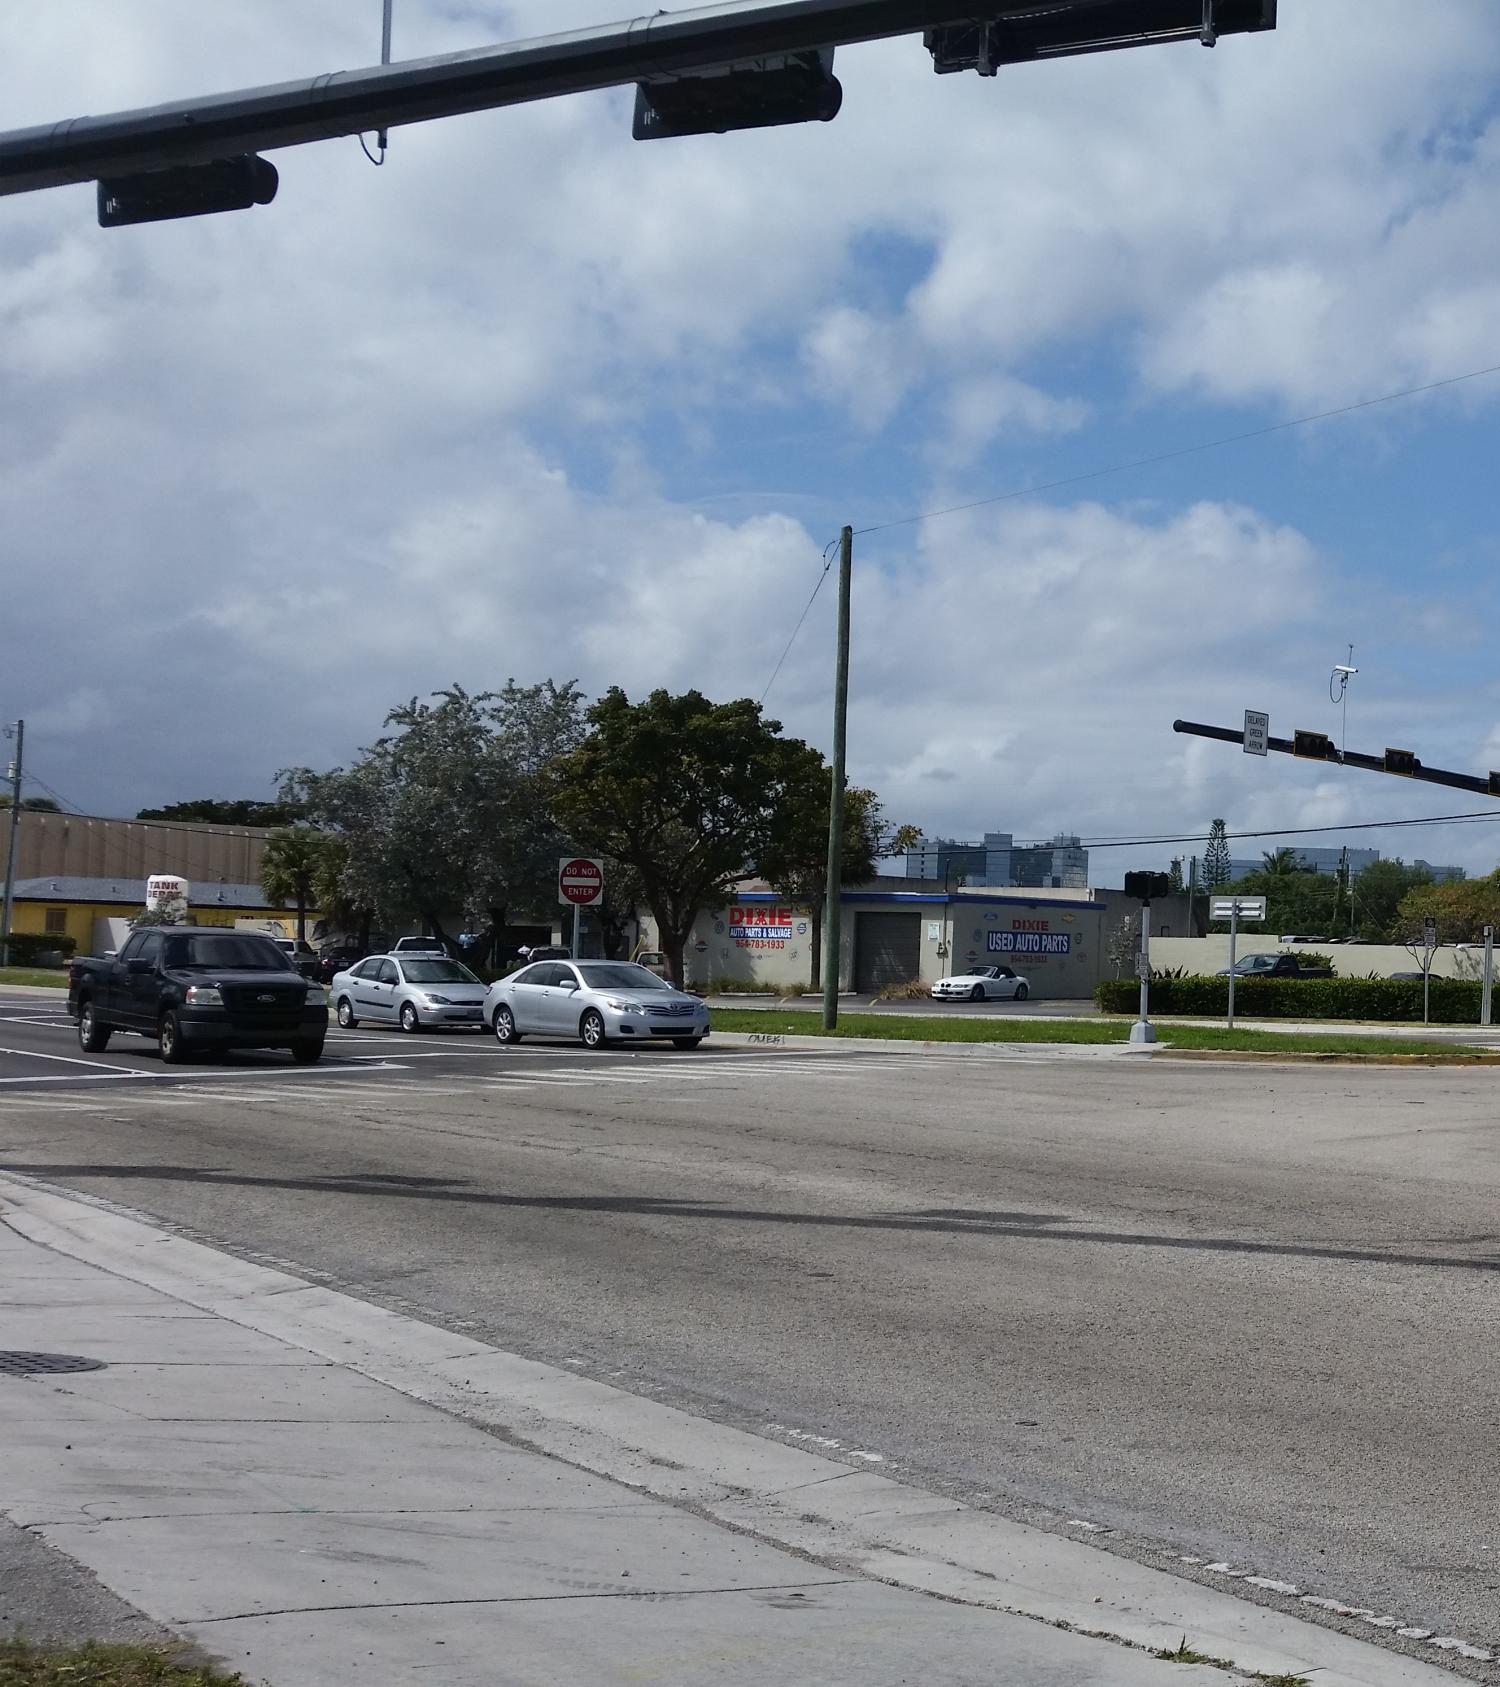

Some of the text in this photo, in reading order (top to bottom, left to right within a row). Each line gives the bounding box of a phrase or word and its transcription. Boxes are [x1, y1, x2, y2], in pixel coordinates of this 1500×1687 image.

[1250, 729, 1263, 737] GREEN
[1249, 741, 1262, 750] ARROW
[567, 867, 577, 875] DO
[149, 881, 179, 889] TANK
[729, 907, 793, 925] DIXIE
[1012, 920, 1049, 931] DIXIE
[730, 927, 792, 938] AUTO PARTS & SALVAGE
[735, 940, 785, 949] 954-783-1933
[989, 932, 1068, 952] USED AUTO PARTS
